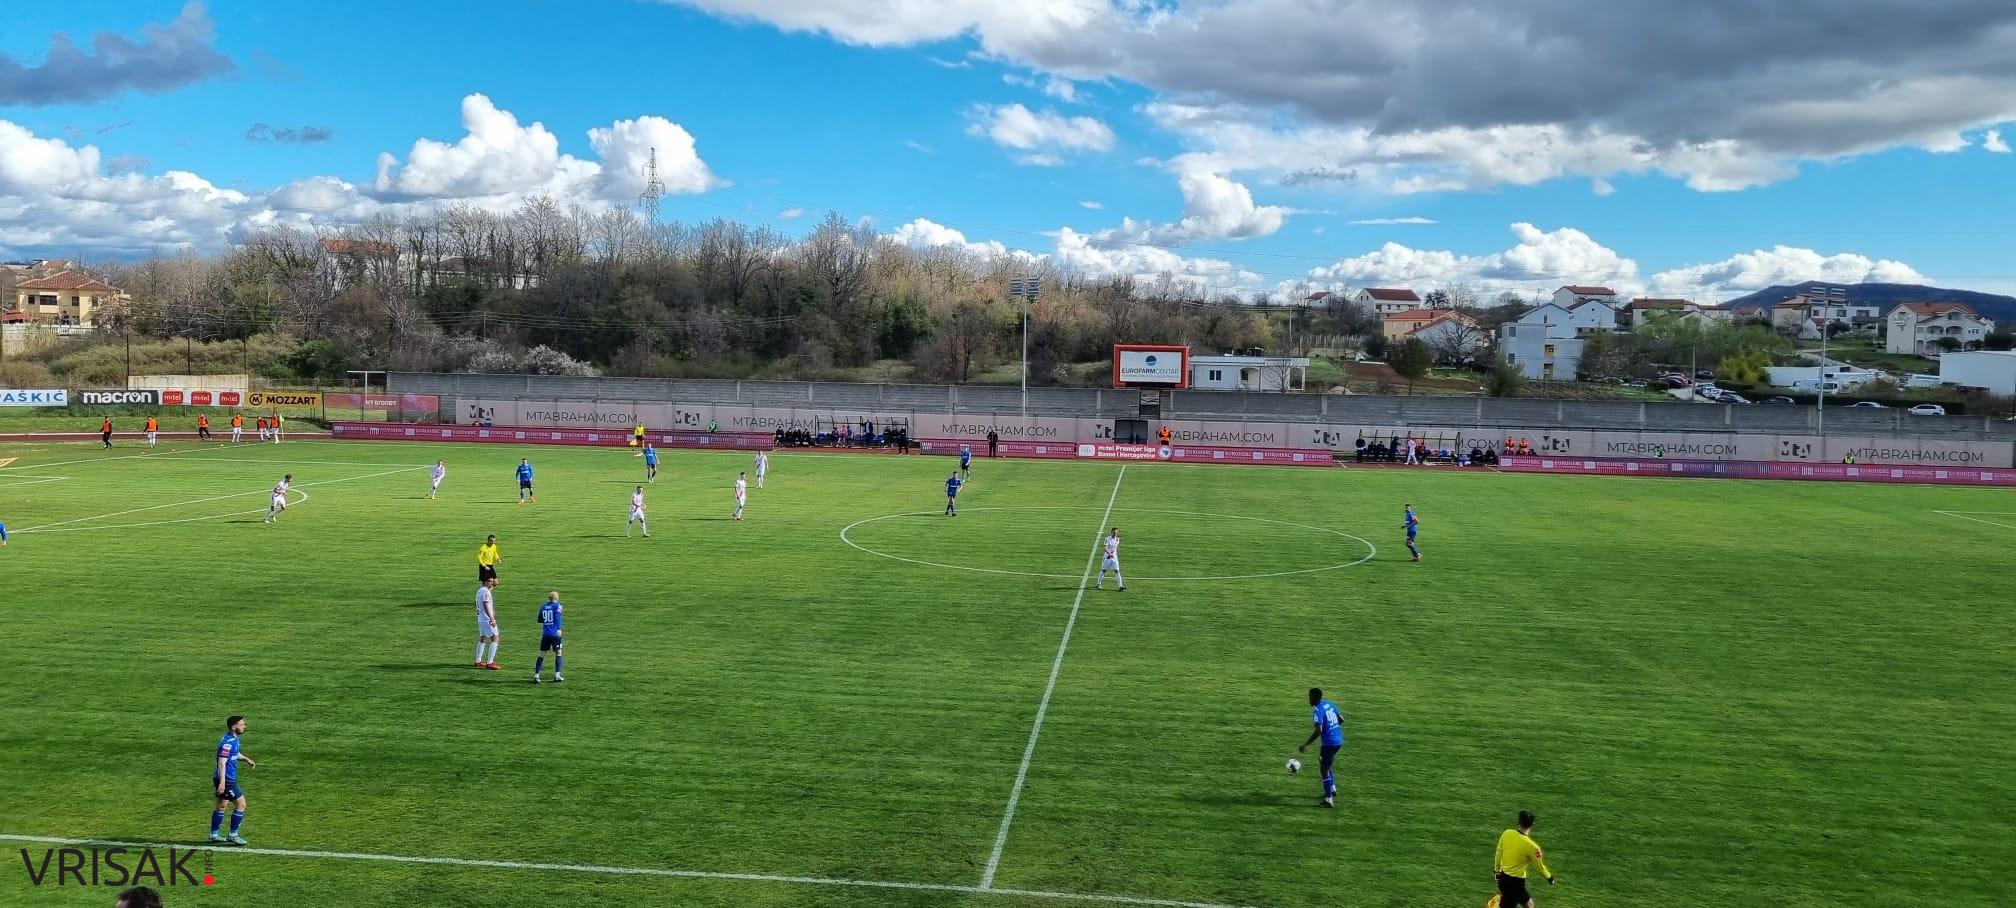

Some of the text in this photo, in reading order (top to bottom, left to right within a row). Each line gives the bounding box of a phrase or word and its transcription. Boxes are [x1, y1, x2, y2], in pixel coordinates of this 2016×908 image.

[0, 390, 64, 402] AŠKIĆ
[83, 391, 152, 404] macron
[266, 395, 317, 405] MOZZART
[526, 411, 638, 424] MTABRAHAM.COM
[942, 424, 1057, 437] MTABRAHAM.COM
[1850, 447, 1984, 462] MTABRAHAM.COM
[542, 610, 554, 623] 90
